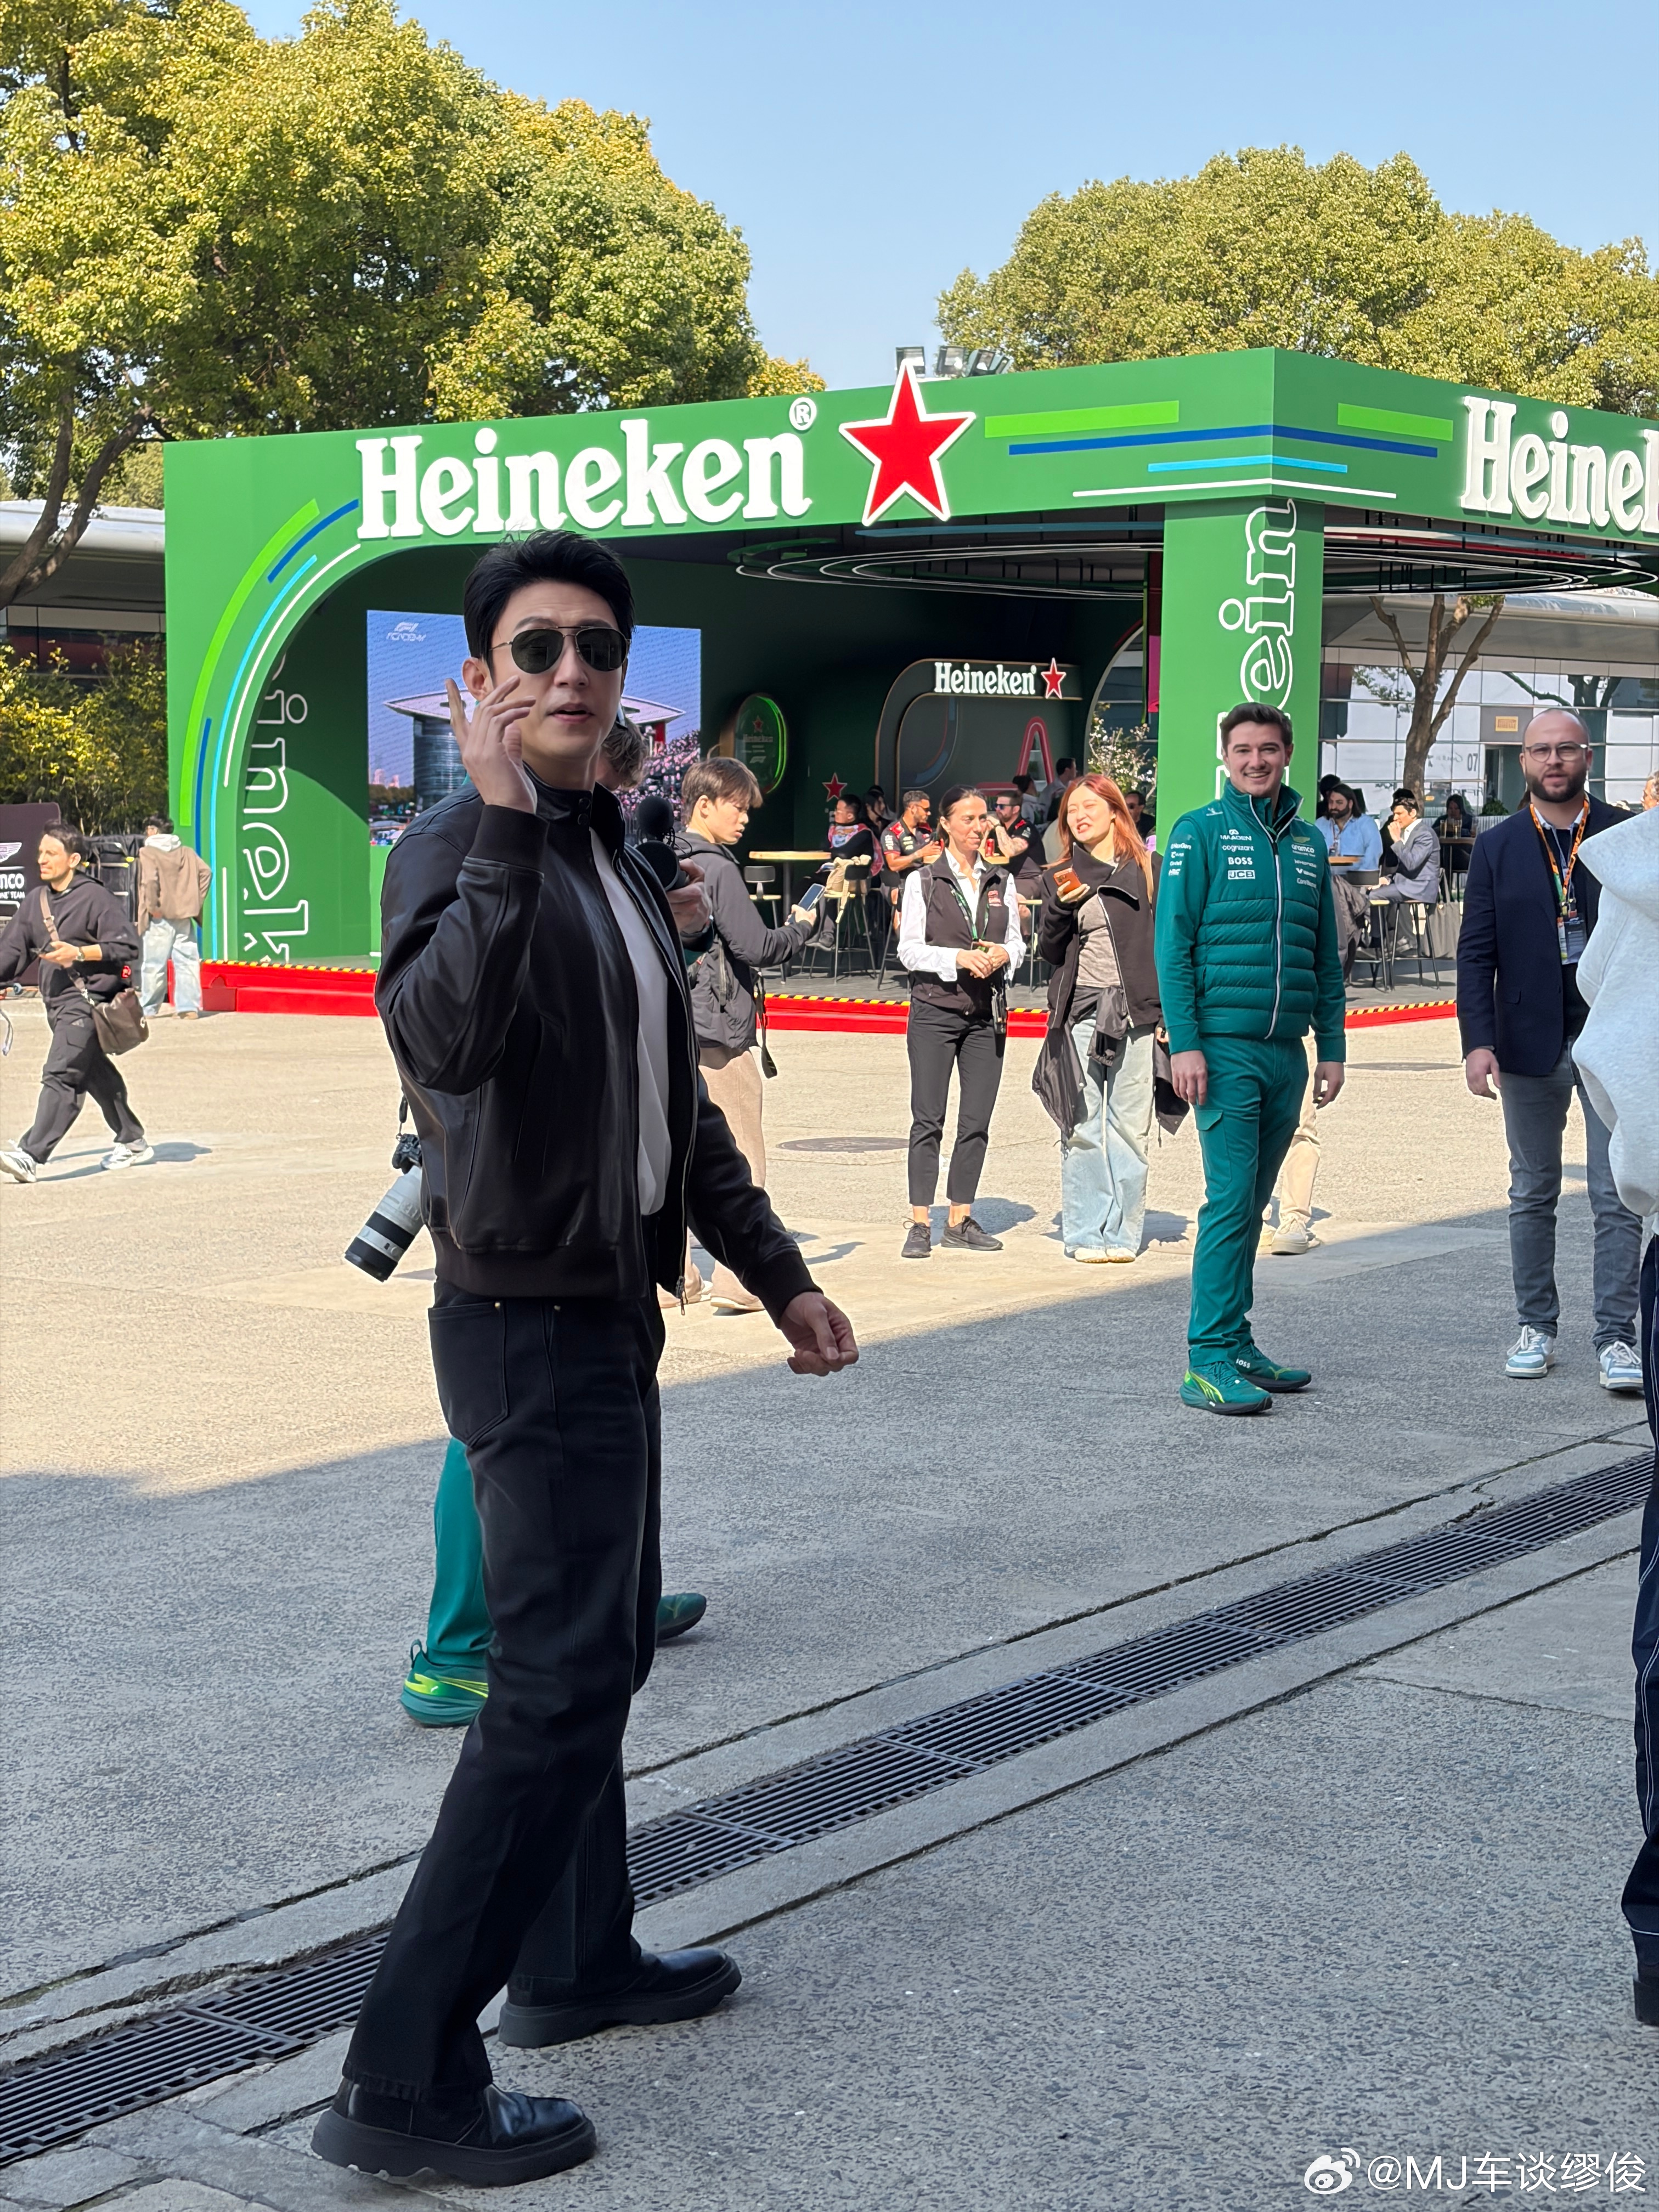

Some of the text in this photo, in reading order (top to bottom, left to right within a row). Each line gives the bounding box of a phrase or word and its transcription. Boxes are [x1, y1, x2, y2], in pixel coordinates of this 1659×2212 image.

[1467, 753, 1478, 772] 07
[1291, 844, 1314, 853] aramco
[1228, 857, 1253, 865] BOSS
[10, 891, 25, 899] TEAM
